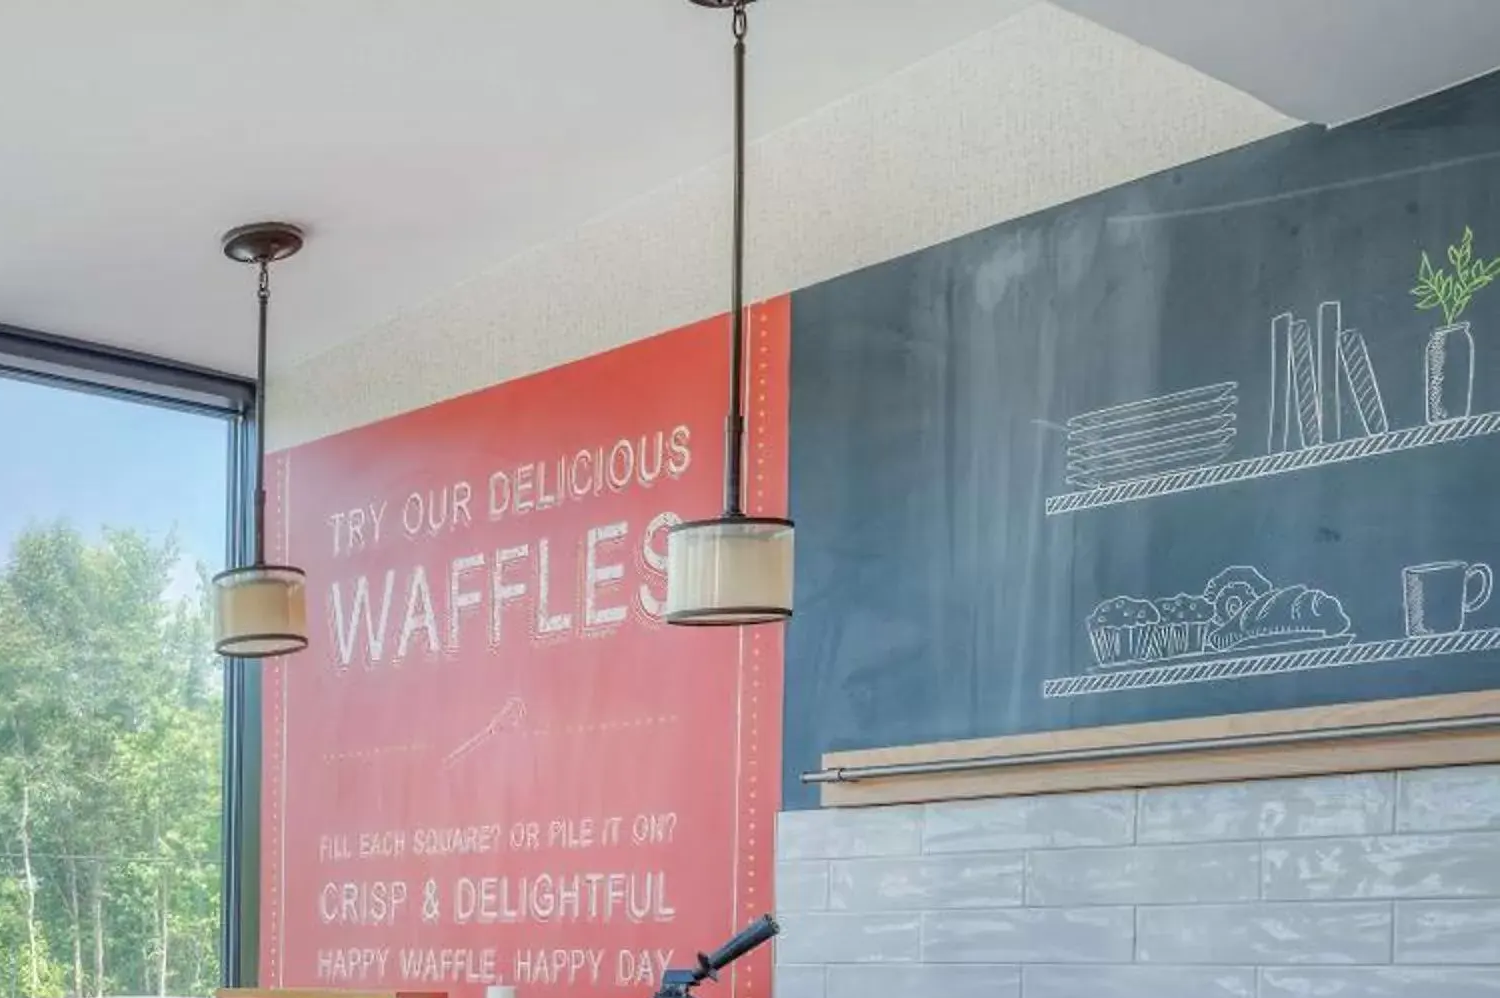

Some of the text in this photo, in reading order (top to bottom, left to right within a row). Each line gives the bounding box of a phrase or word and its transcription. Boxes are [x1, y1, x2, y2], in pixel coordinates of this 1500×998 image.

[328, 425, 692, 557] TRY OUR DELICIOUS
[329, 511, 684, 667] WAFFLES
[359, 829, 406, 859] EACH
[412, 823, 501, 856] SQUARE?
[510, 820, 540, 851] OR
[549, 815, 594, 848] PILE
[602, 815, 623, 847] IT
[631, 811, 677, 847] ON?
[319, 871, 677, 924] CRISP & DELIGHTFUL
[317, 947, 388, 980] HAPPY
[514, 948, 605, 984] HAPPY
[617, 947, 675, 986] DAY
